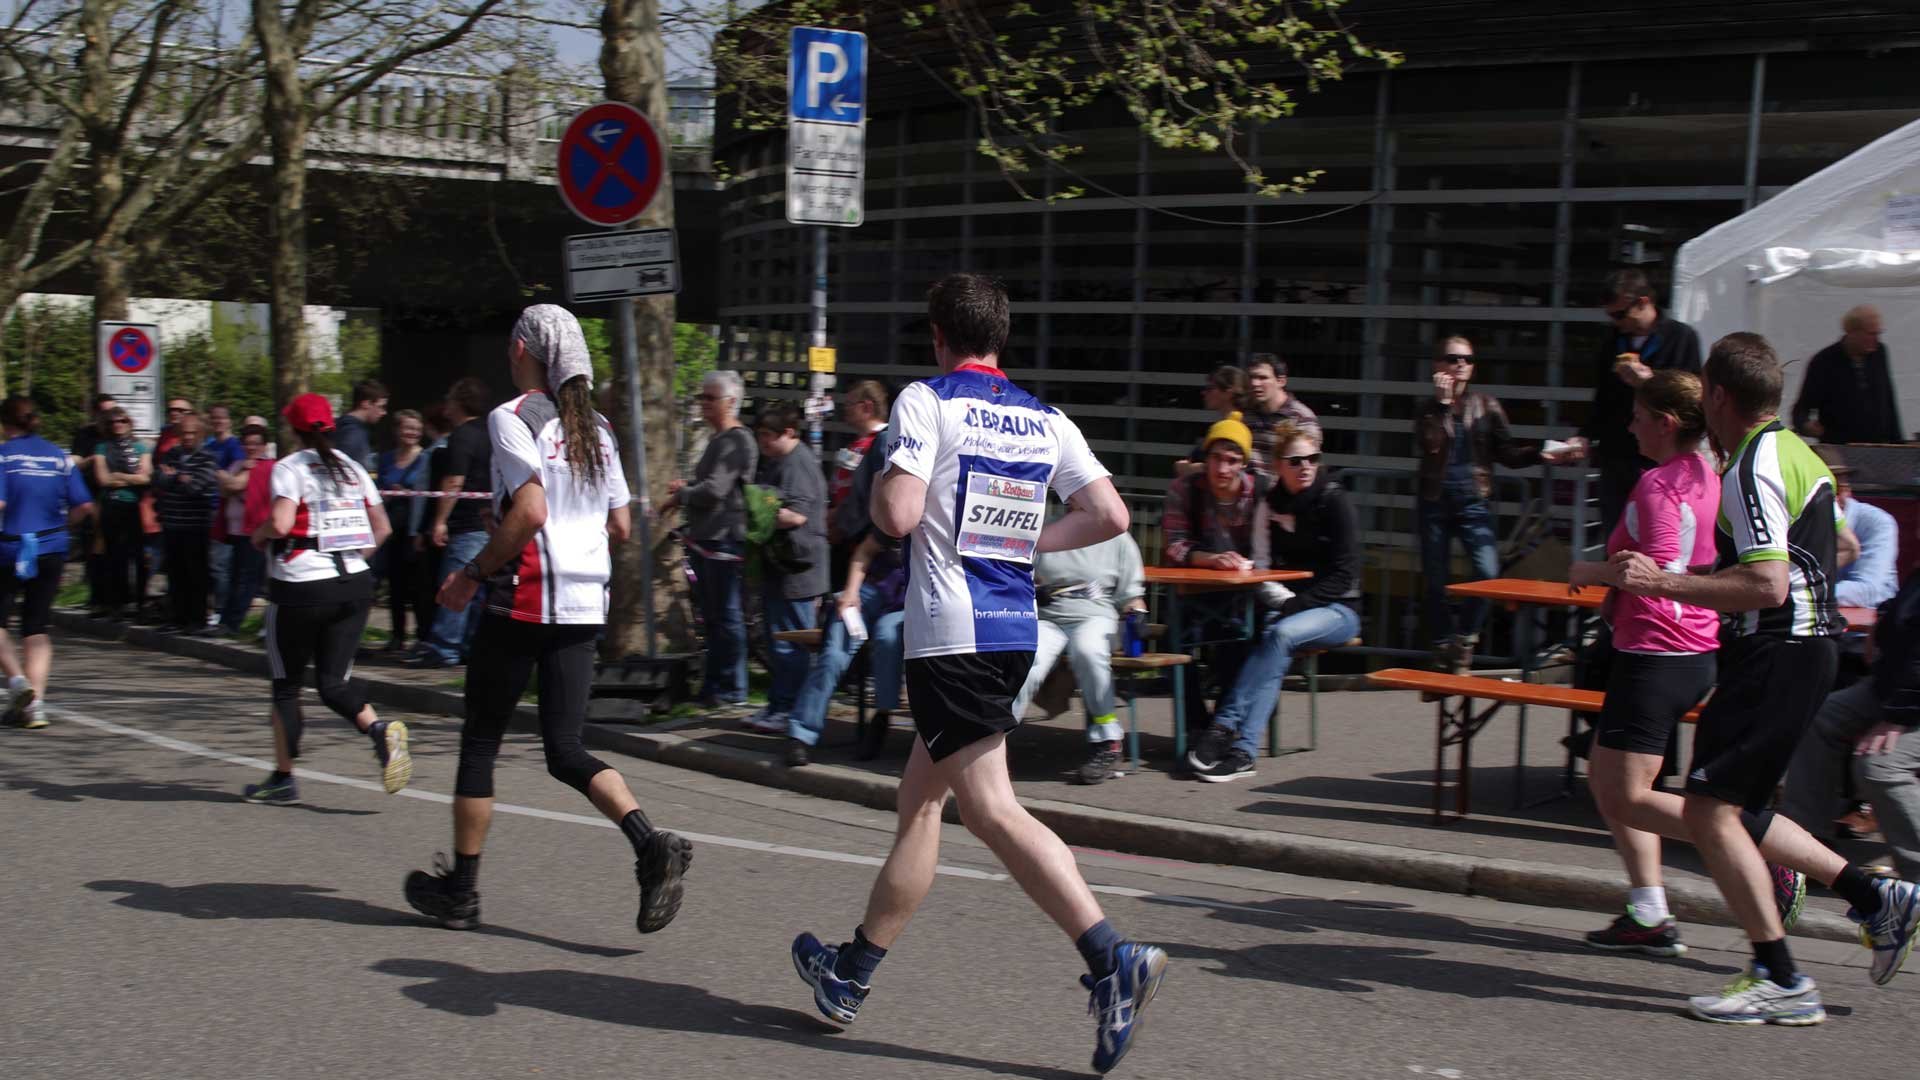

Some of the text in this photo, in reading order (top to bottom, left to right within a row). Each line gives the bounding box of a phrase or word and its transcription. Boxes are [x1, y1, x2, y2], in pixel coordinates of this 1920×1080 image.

[807, 41, 849, 108] P
[980, 408, 1047, 438] BRAUN
[967, 504, 1039, 531] STAFFEL
